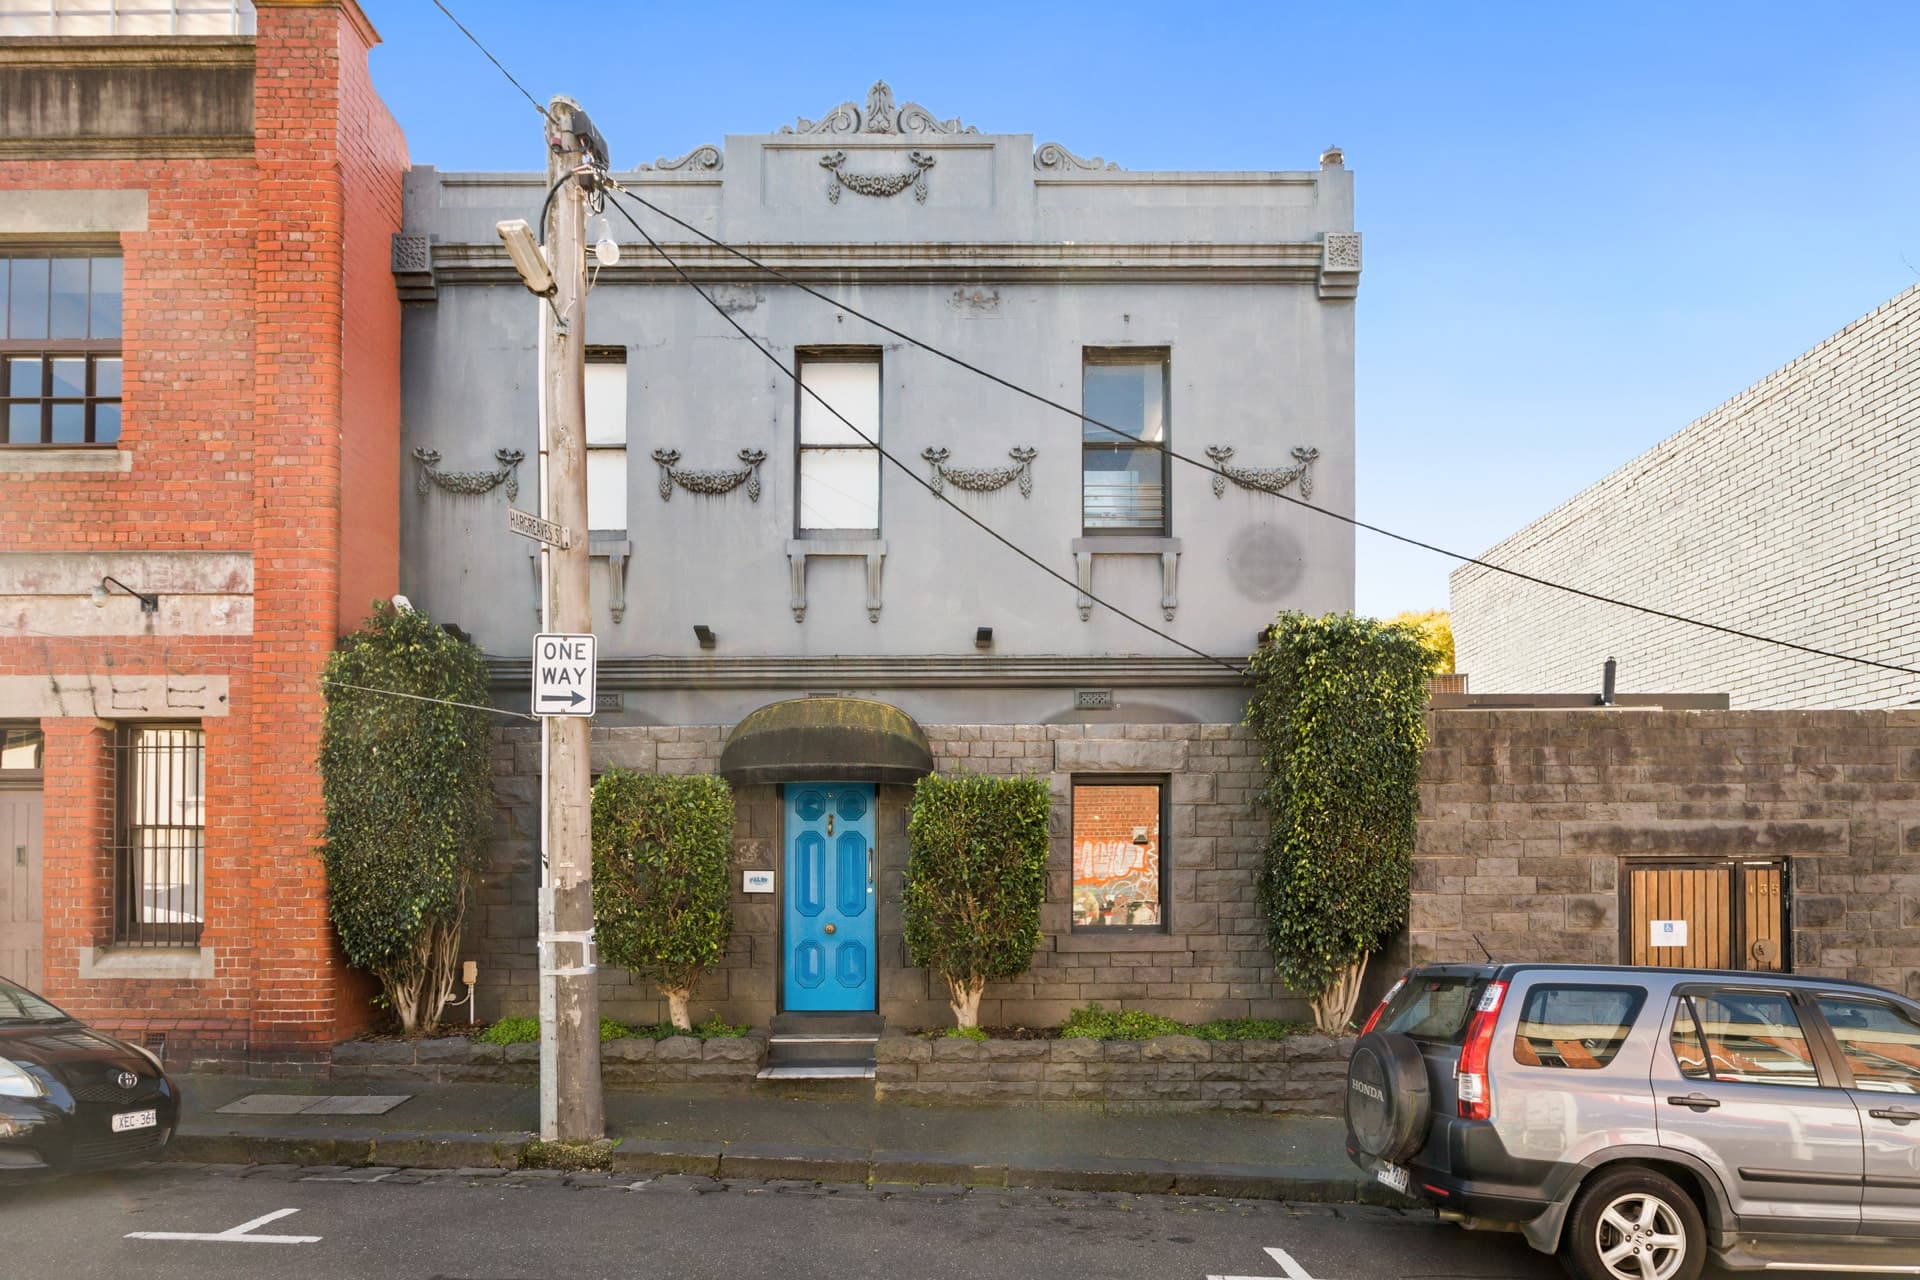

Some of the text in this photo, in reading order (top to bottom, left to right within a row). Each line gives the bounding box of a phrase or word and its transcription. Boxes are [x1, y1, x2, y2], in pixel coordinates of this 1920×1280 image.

[510, 511, 553, 541] HARGREAVES
[544, 642, 586, 660] ONE
[542, 667, 587, 685] WAY
[1351, 1078, 1385, 1103] HONDA
